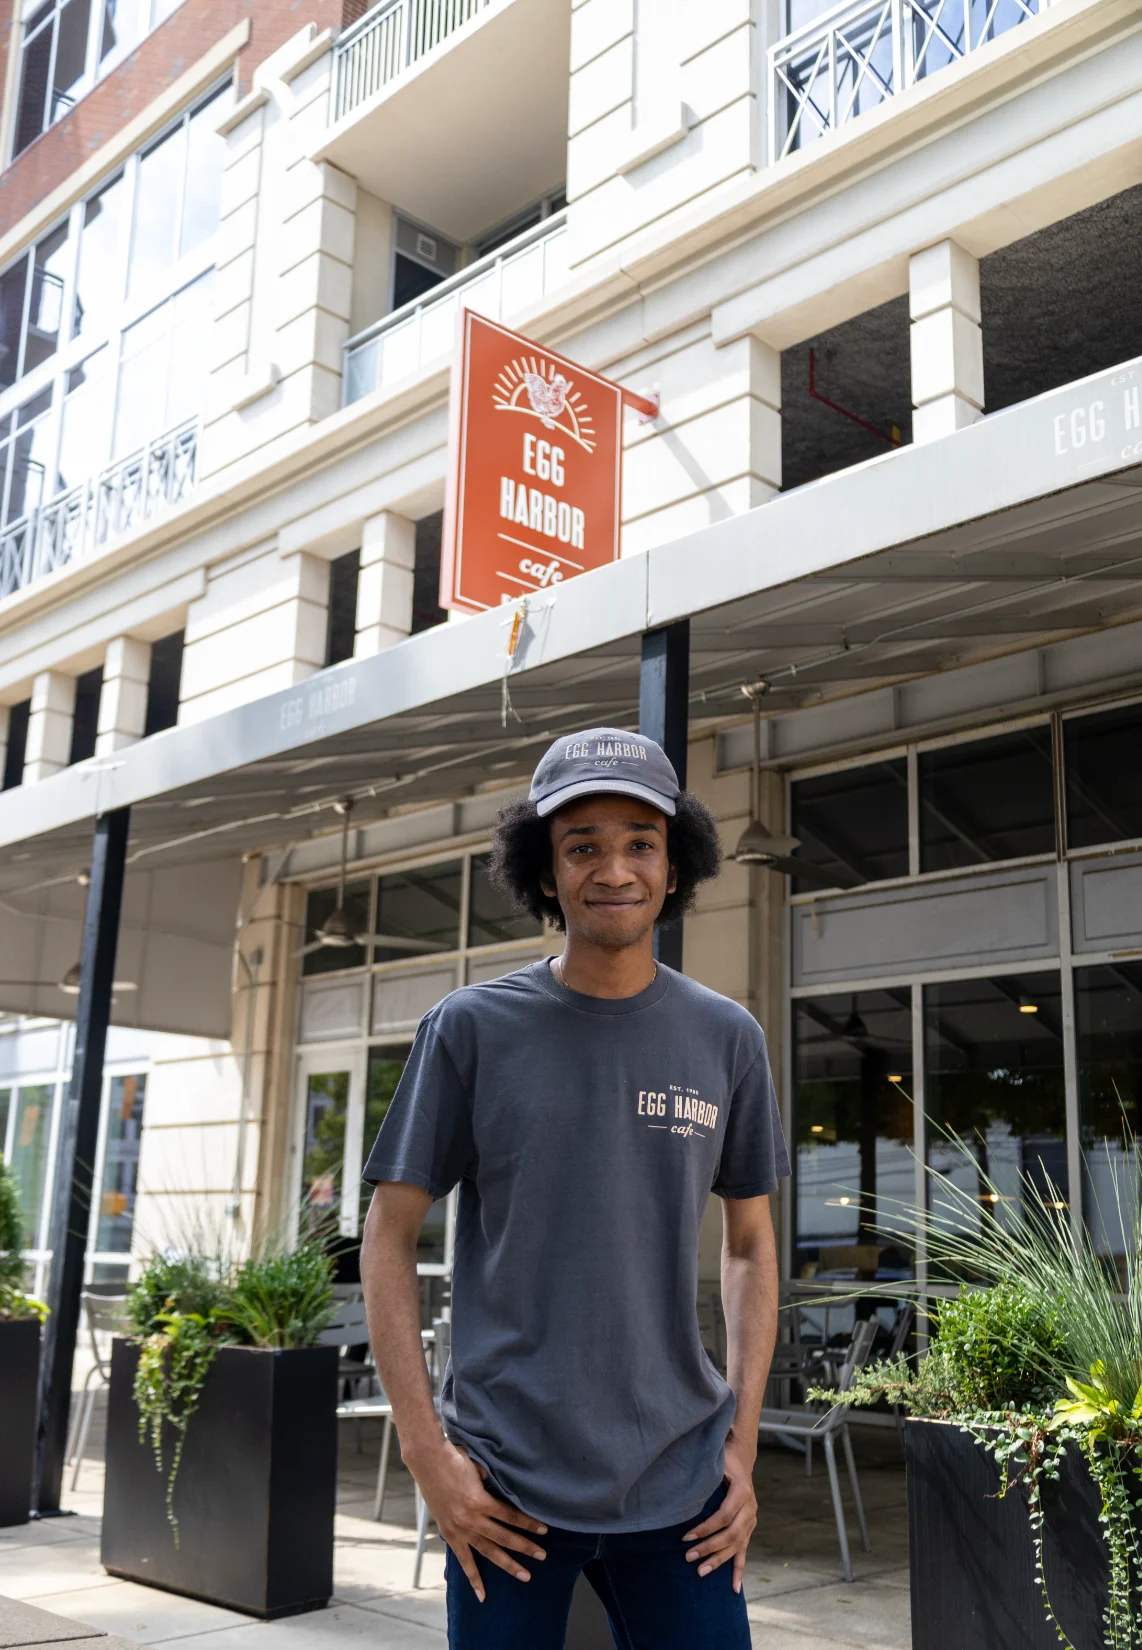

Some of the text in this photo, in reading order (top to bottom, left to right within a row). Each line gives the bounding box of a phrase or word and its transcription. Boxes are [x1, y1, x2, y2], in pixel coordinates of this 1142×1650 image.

[1053, 400, 1106, 456] EGG
[523, 432, 565, 487] EGG
[500, 476, 585, 550] HARBOR
[519, 557, 564, 587] cafe
[565, 741, 647, 761] EGG HARBOR
[594, 757, 619, 768] cafe
[638, 1091, 718, 1129] EGG HARBOR
[670, 1123, 694, 1137] cafe
